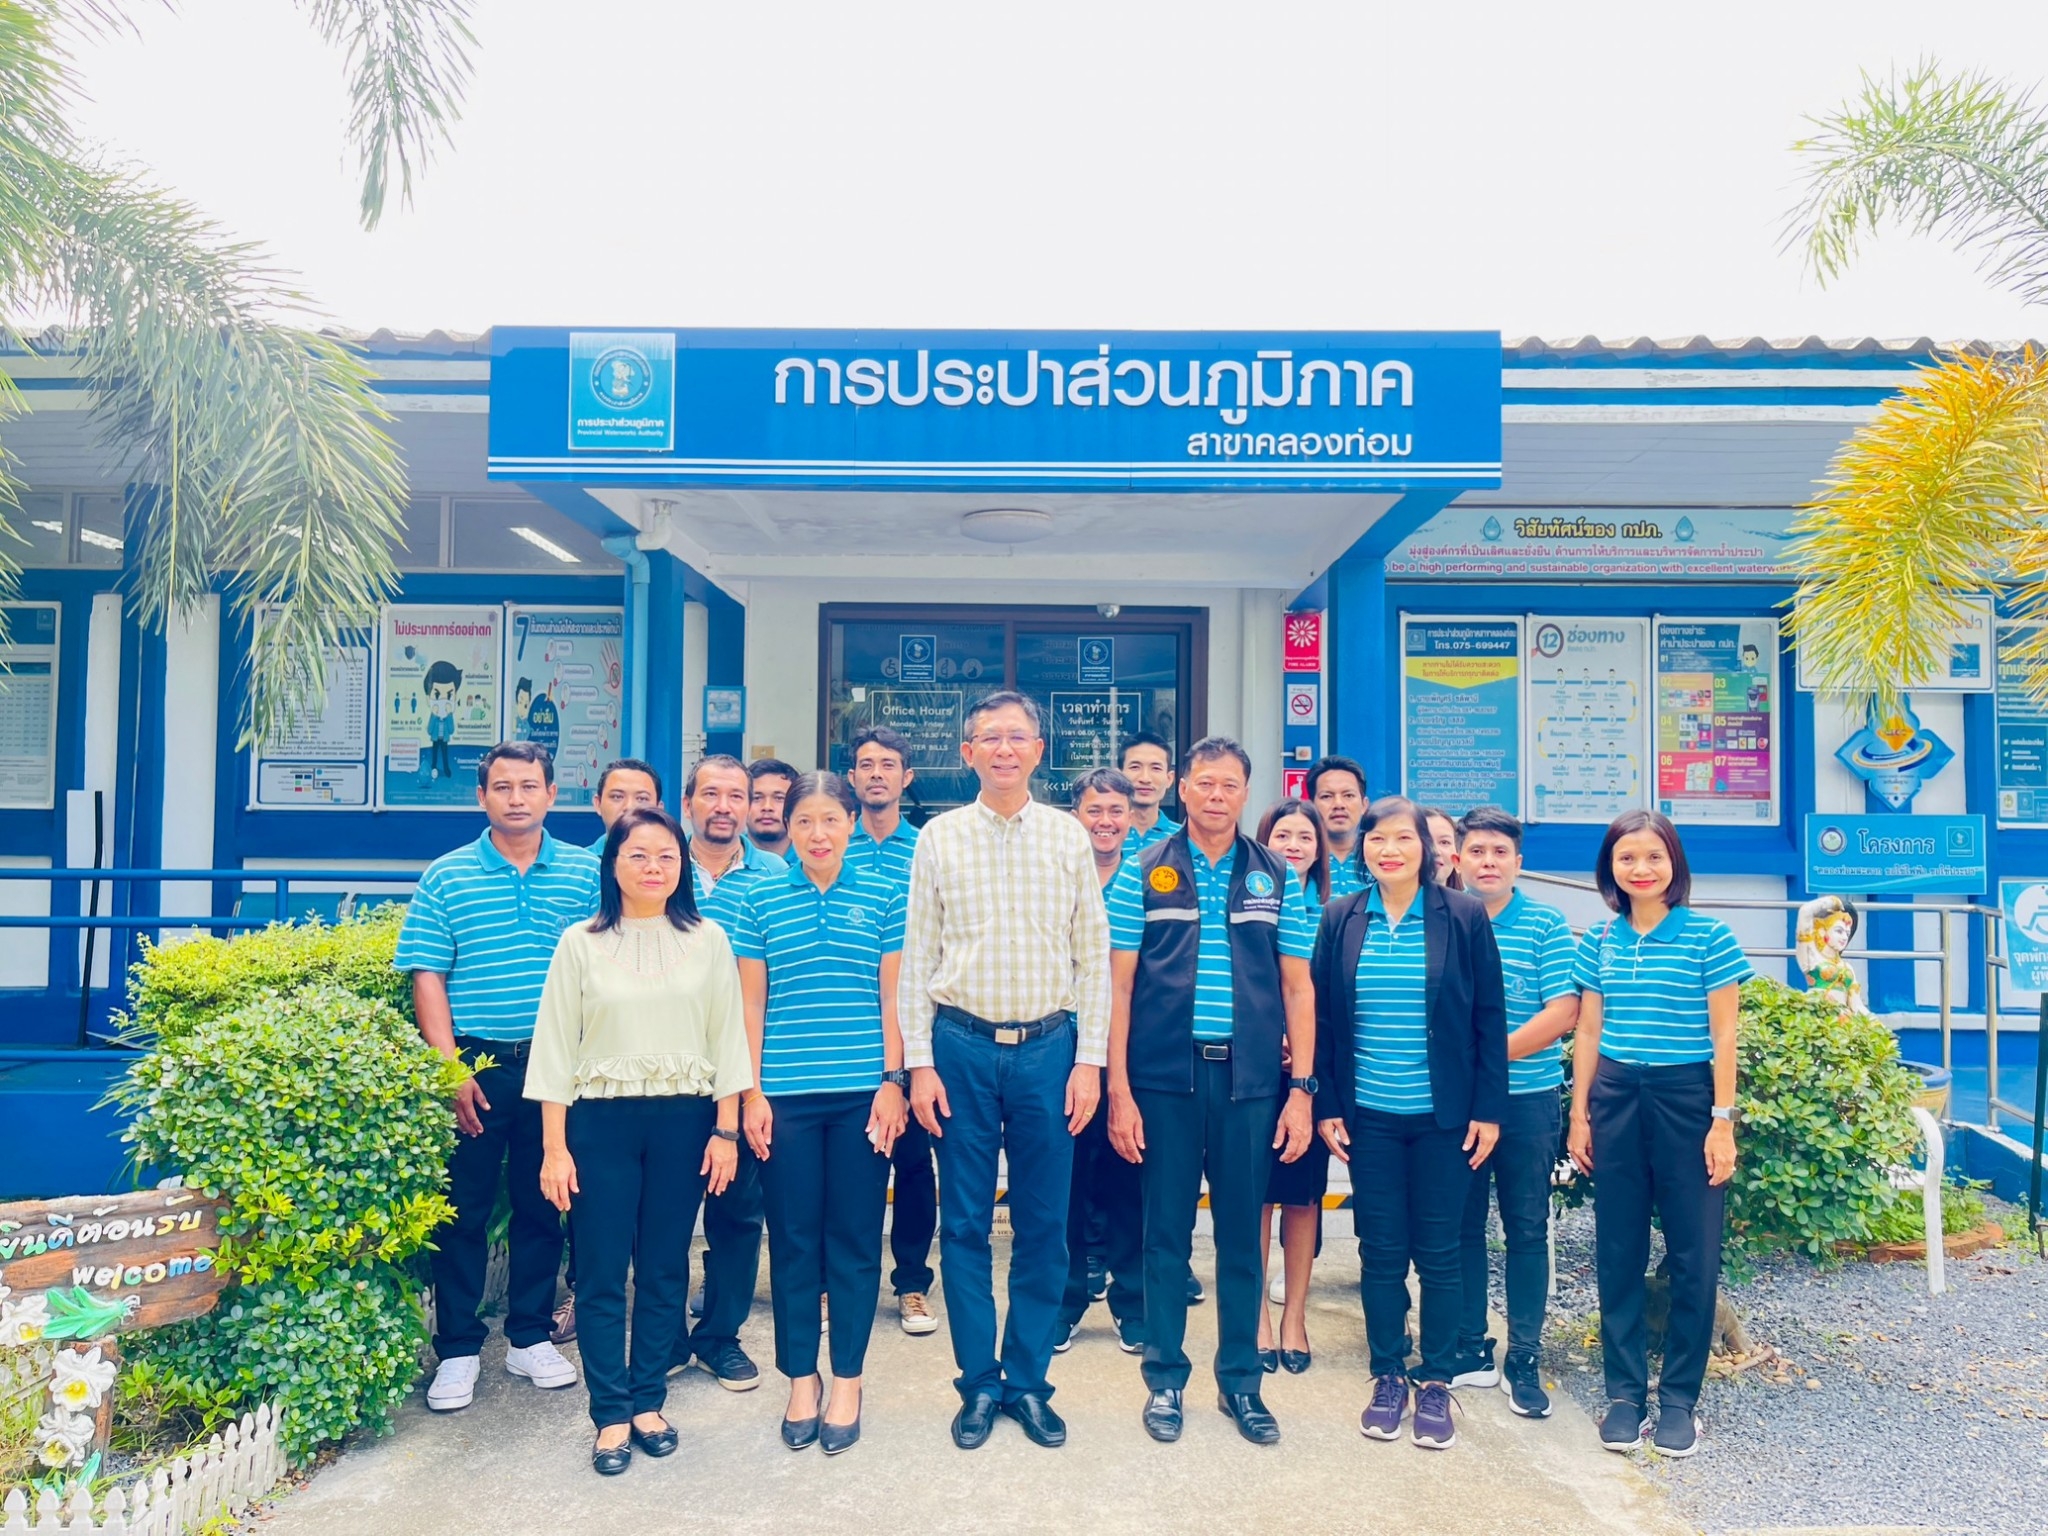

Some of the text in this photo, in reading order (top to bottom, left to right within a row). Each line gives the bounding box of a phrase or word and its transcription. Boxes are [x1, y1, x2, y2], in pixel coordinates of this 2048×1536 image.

[774, 344, 1413, 425] การประปาส่วนภูมิภาค
[1187, 428, 1413, 457] สาขาคลองท่อม
[1514, 516, 1662, 538] วิสัยทัศน์ของ กปภ.
[1392, 562, 1405, 572] be
[1419, 562, 1441, 575] high
[1446, 562, 1503, 574] performing
[1507, 562, 1525, 572] and
[1530, 562, 1588, 573] sustainable
[1593, 562, 1657, 574] organization
[1661, 562, 1683, 573] with
[1687, 562, 1734, 573] excellent
[1542, 624, 1625, 648] 12 ช่องทาง
[1434, 640, 1511, 650] โทร.075-699447
[1714, 678, 1726, 688] 03
[882, 706, 952, 715] Office Hours
[1062, 699, 1130, 714] เวลาทำการ
[1714, 716, 1726, 726] 05
[1661, 755, 1672, 765] 06
[1714, 756, 1727, 766] 07
[1857, 829, 1935, 854] โครงการ
[72, 1254, 212, 1290] welcome
